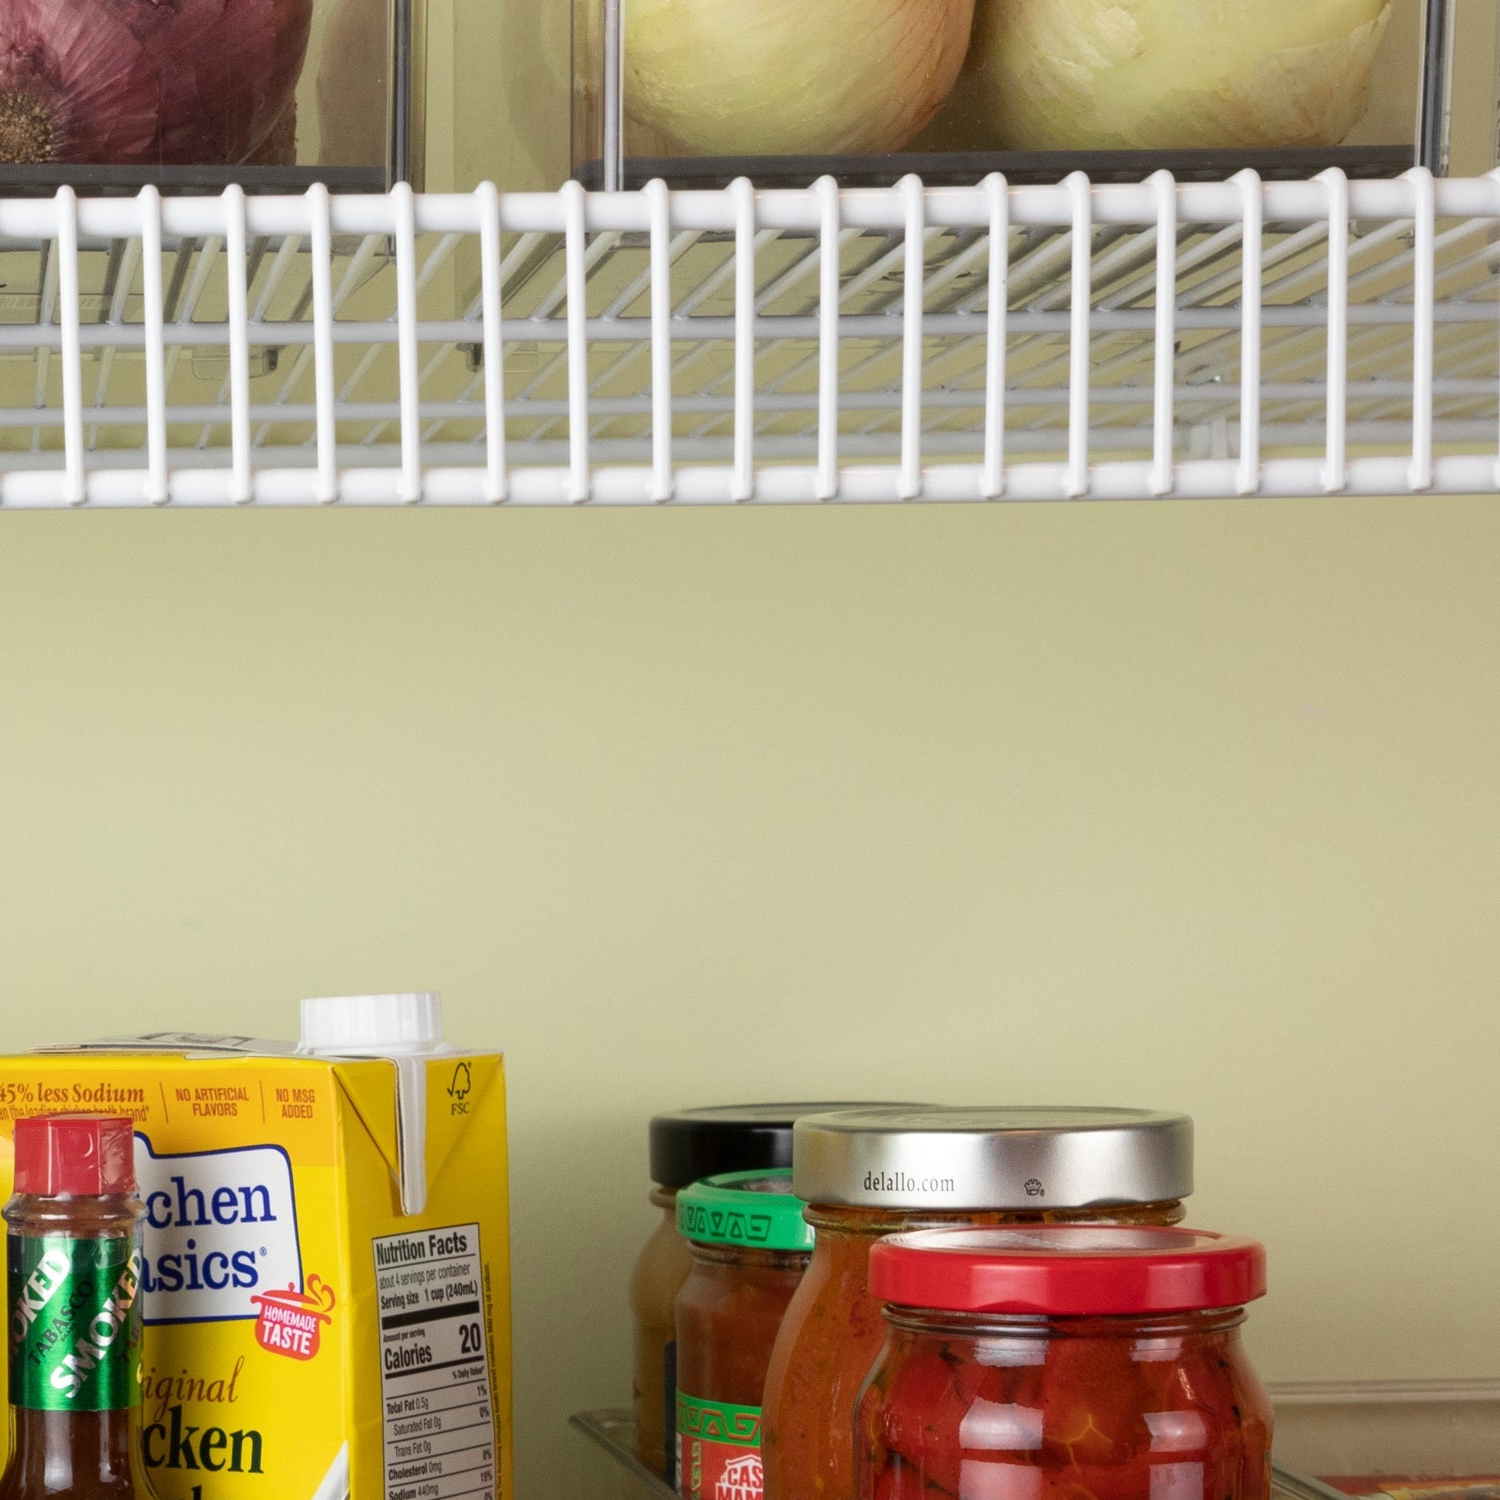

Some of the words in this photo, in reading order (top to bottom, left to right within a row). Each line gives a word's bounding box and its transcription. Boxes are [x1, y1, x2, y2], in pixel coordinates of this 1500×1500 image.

[37, 1084, 69, 1102] less
[72, 1083, 145, 1103] Sodium
[175, 1089, 190, 1102] NO
[195, 1087, 249, 1102] ARTIFICIAL
[276, 1088, 289, 1102] NO
[292, 1088, 315, 1102] MSG
[193, 1102, 237, 1117] FLAVORS
[281, 1103, 313, 1118] ADDED
[451, 1102, 470, 1115] FSC
[864, 1171, 955, 1192] delallo.com
[146, 1176, 276, 1229] chen
[376, 1238, 426, 1266] Nutrition
[428, 1232, 467, 1256] Facts
[143, 1239, 259, 1293] asics
[379, 1272, 395, 1290] about
[401, 1269, 425, 1287] servings
[438, 1263, 470, 1280] container
[381, 1291, 406, 1310] Serving
[431, 1287, 445, 1302] cup
[446, 1280, 478, 1301] (240mL)
[27, 1280, 94, 1366] TABASCO
[50, 1248, 143, 1398] SMOKED
[264, 1305, 316, 1333] HOMEMADE
[262, 1321, 312, 1355] TASTE
[385, 1343, 432, 1370] Calories
[459, 1322, 481, 1354] 20
[143, 1406, 264, 1474] cken
[389, 1463, 427, 1481] Cholesterol
[728, 1465, 763, 1486] CAS
